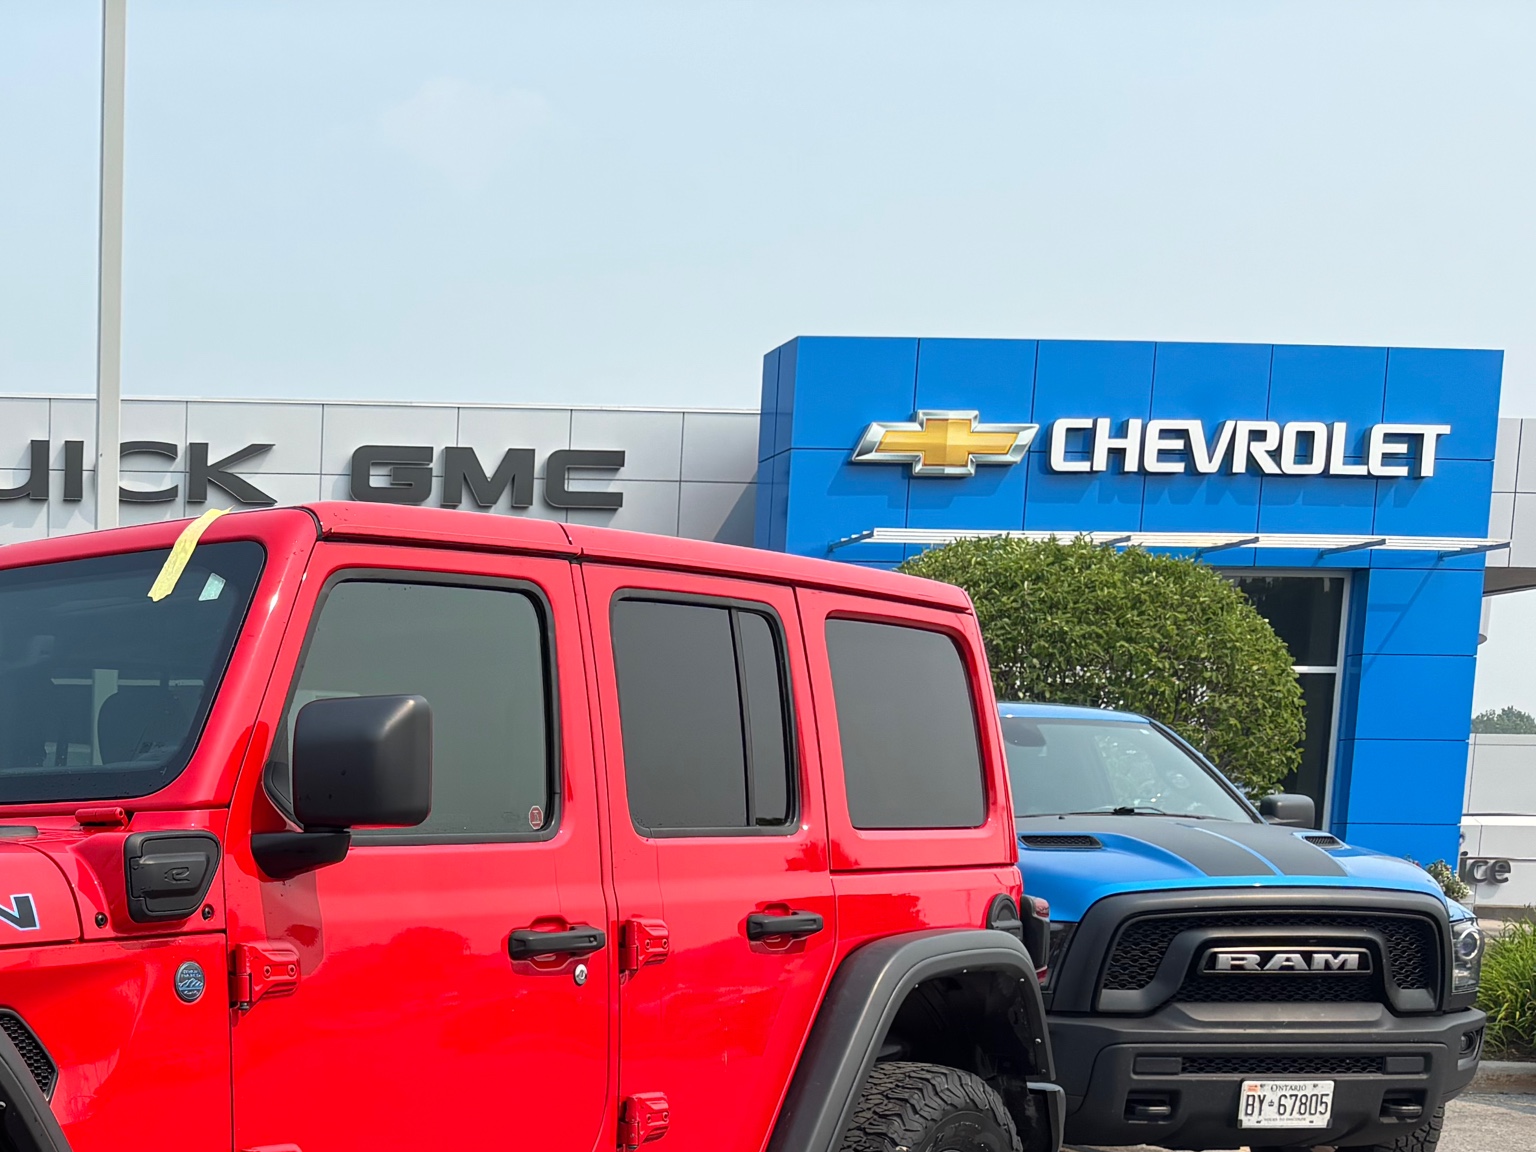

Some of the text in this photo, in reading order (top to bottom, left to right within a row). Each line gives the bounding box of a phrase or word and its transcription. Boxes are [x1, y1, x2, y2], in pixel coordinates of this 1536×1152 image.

[1050, 417, 1452, 478] CHEVROLET
[350, 444, 626, 510] GMC
[1215, 953, 1360, 971] RAM
[1244, 1093, 1331, 1117] BY 67805
